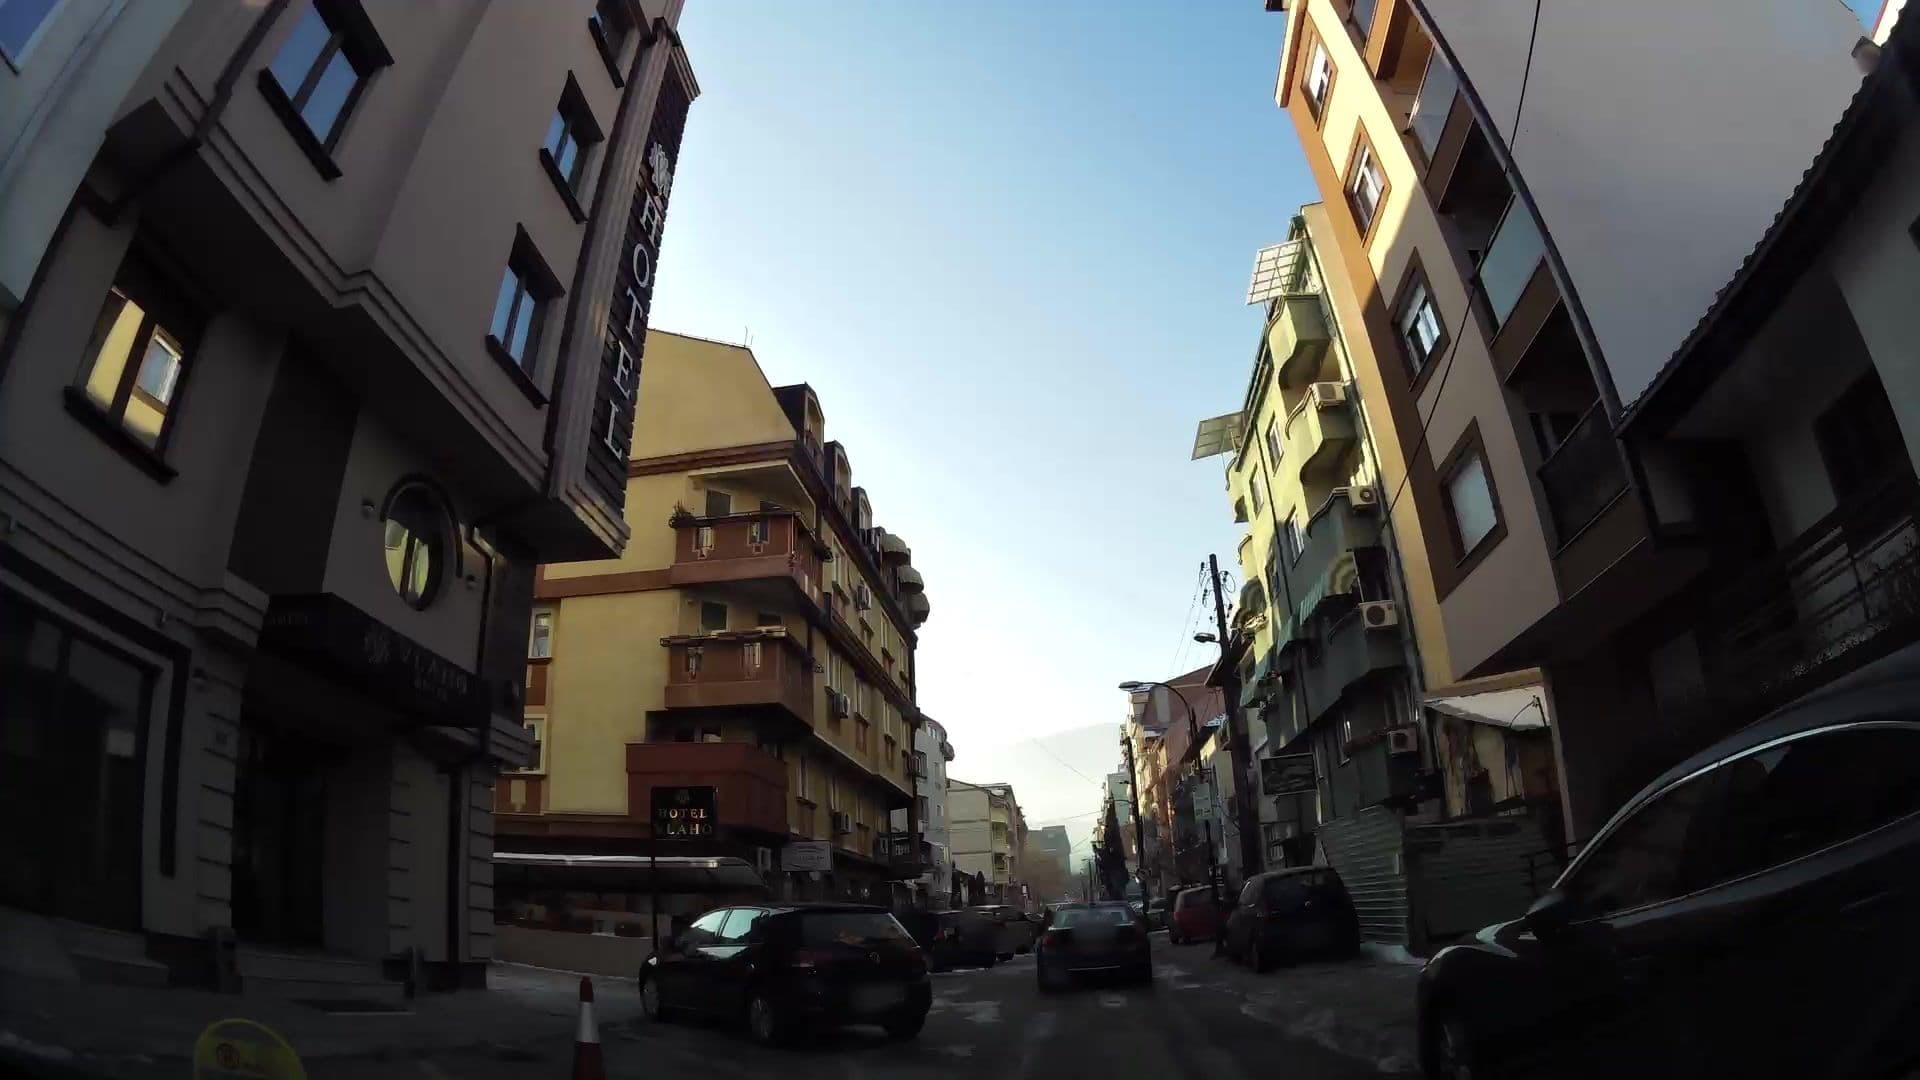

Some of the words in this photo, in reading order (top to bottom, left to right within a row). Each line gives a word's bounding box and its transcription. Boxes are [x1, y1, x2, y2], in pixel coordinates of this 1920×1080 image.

[603, 187, 666, 463] HOTEL
[657, 808, 708, 819] HOTEL
[657, 824, 712, 835] LAHO
